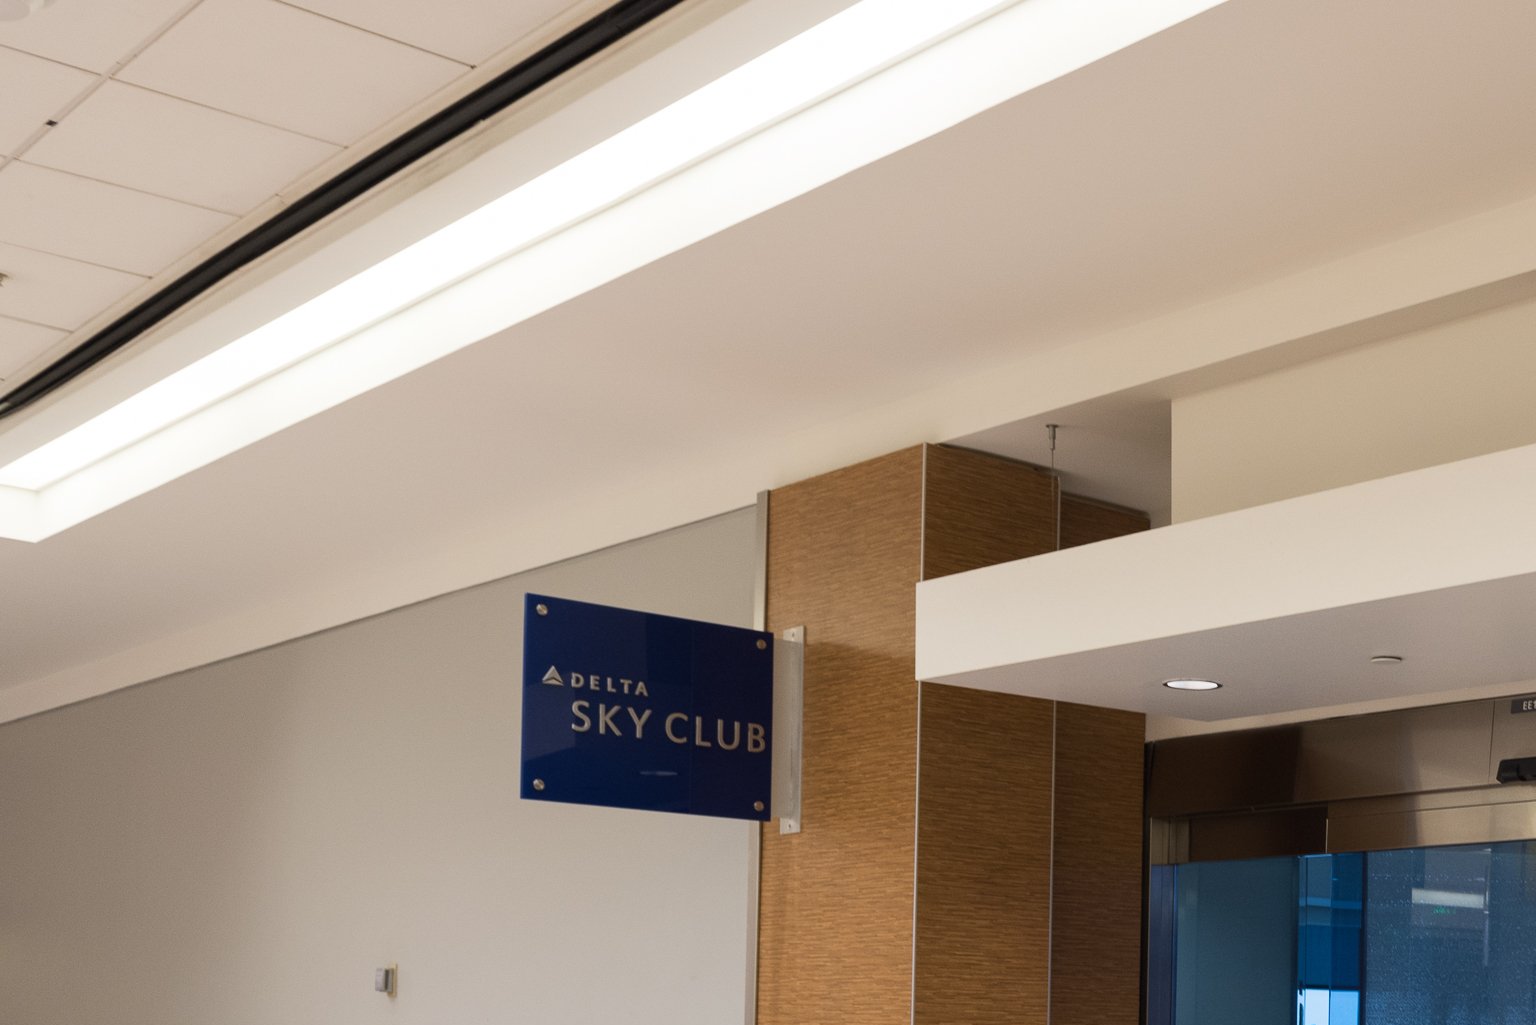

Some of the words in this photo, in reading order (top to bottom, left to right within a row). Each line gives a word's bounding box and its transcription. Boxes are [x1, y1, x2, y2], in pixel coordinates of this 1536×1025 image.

[571, 672, 648, 696] DELTA
[572, 700, 652, 739] SKY
[665, 712, 766, 752] CLUB
